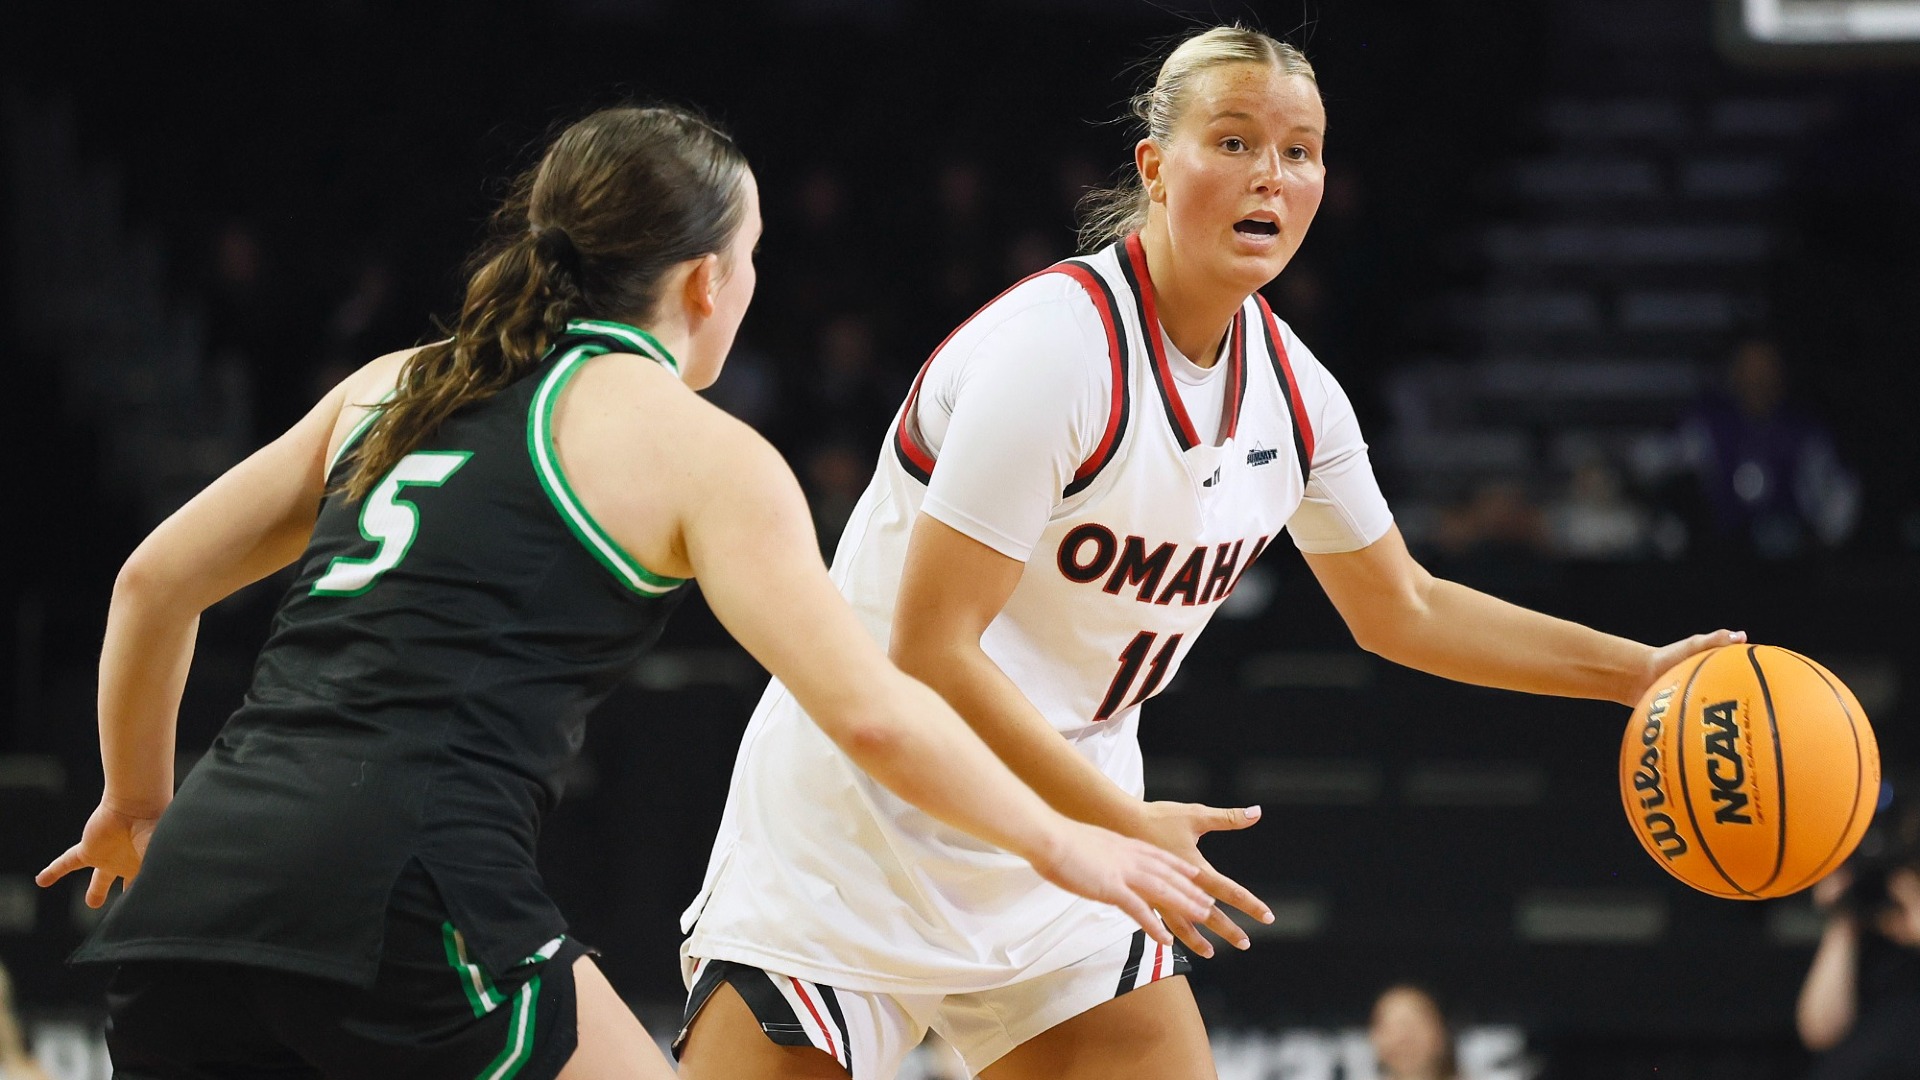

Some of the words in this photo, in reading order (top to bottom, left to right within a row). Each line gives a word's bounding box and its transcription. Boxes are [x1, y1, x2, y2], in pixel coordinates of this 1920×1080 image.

[308, 450, 475, 597] 5
[1092, 630, 1184, 721] 11
[1634, 683, 1688, 861] Wilson
[1703, 699, 1752, 825] NCAA
